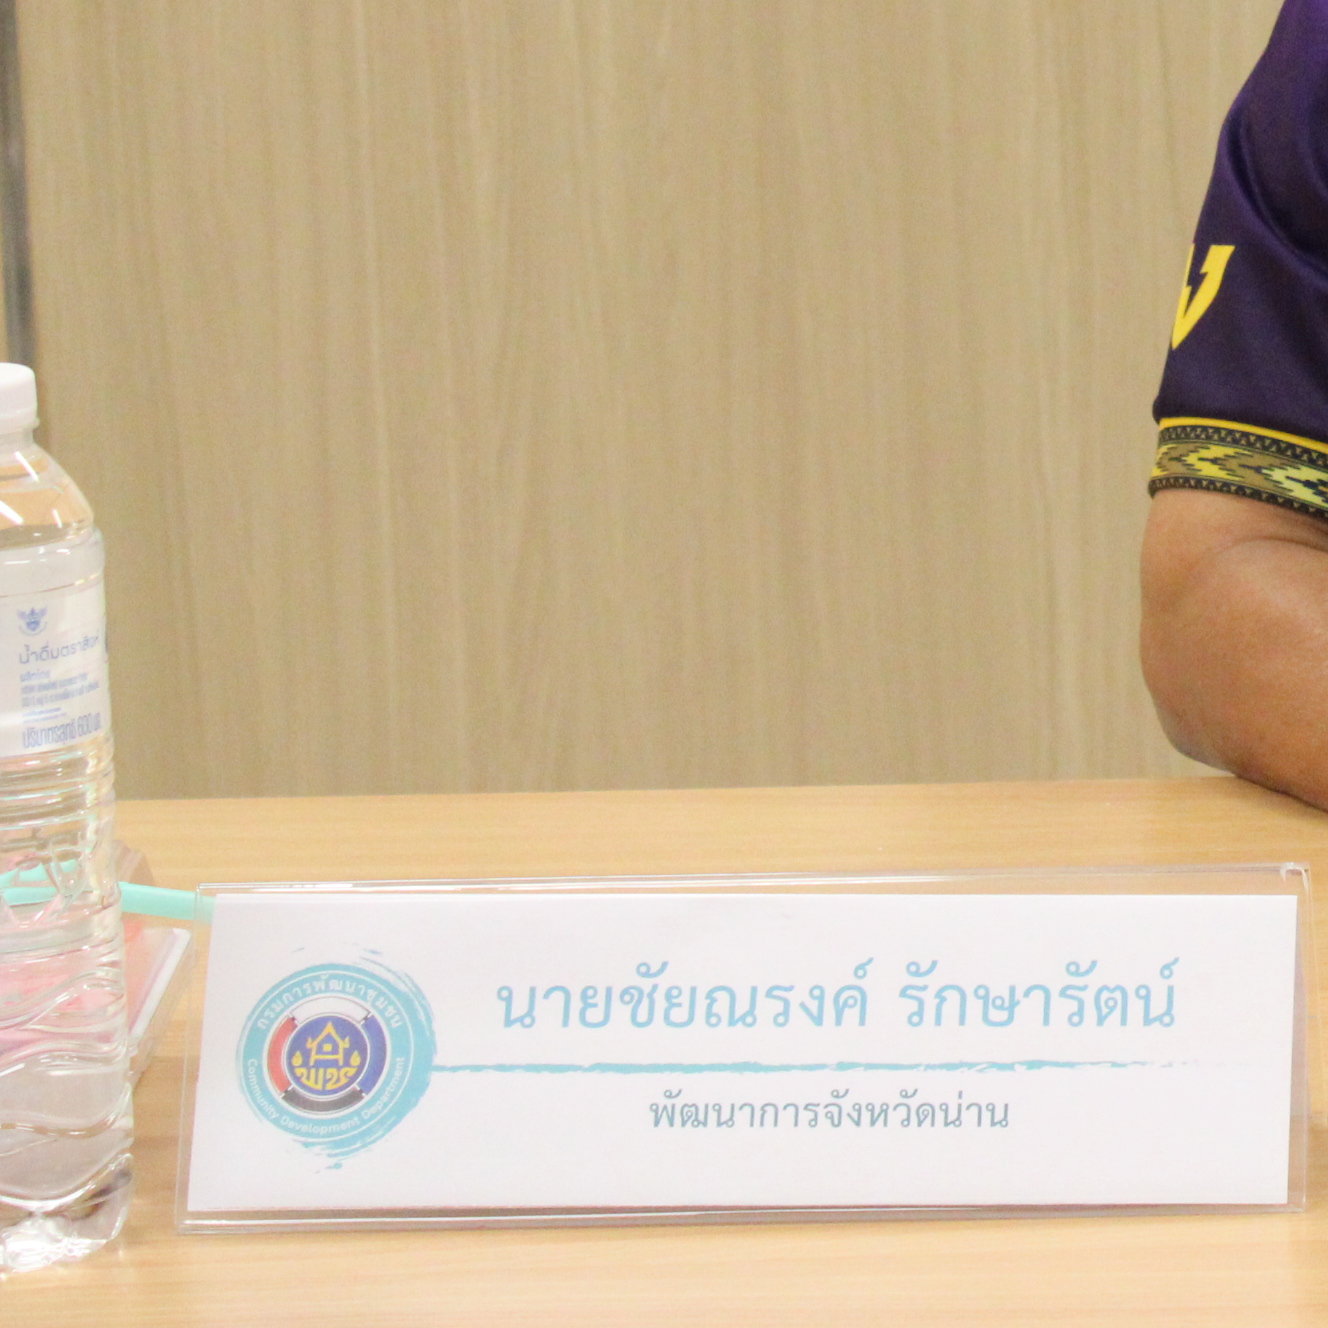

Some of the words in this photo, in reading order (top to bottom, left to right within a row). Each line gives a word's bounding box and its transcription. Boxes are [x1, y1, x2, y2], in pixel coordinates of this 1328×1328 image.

[497, 957, 874, 1029] นายชัยณรงค์
[899, 957, 1180, 1028] รักษารัตน์
[247, 1057, 280, 1119] Community
[281, 1115, 360, 1136] Development
[361, 1056, 405, 1119] Department
[649, 1088, 1010, 1129] พัฒนาการจังหวัดน่าน
